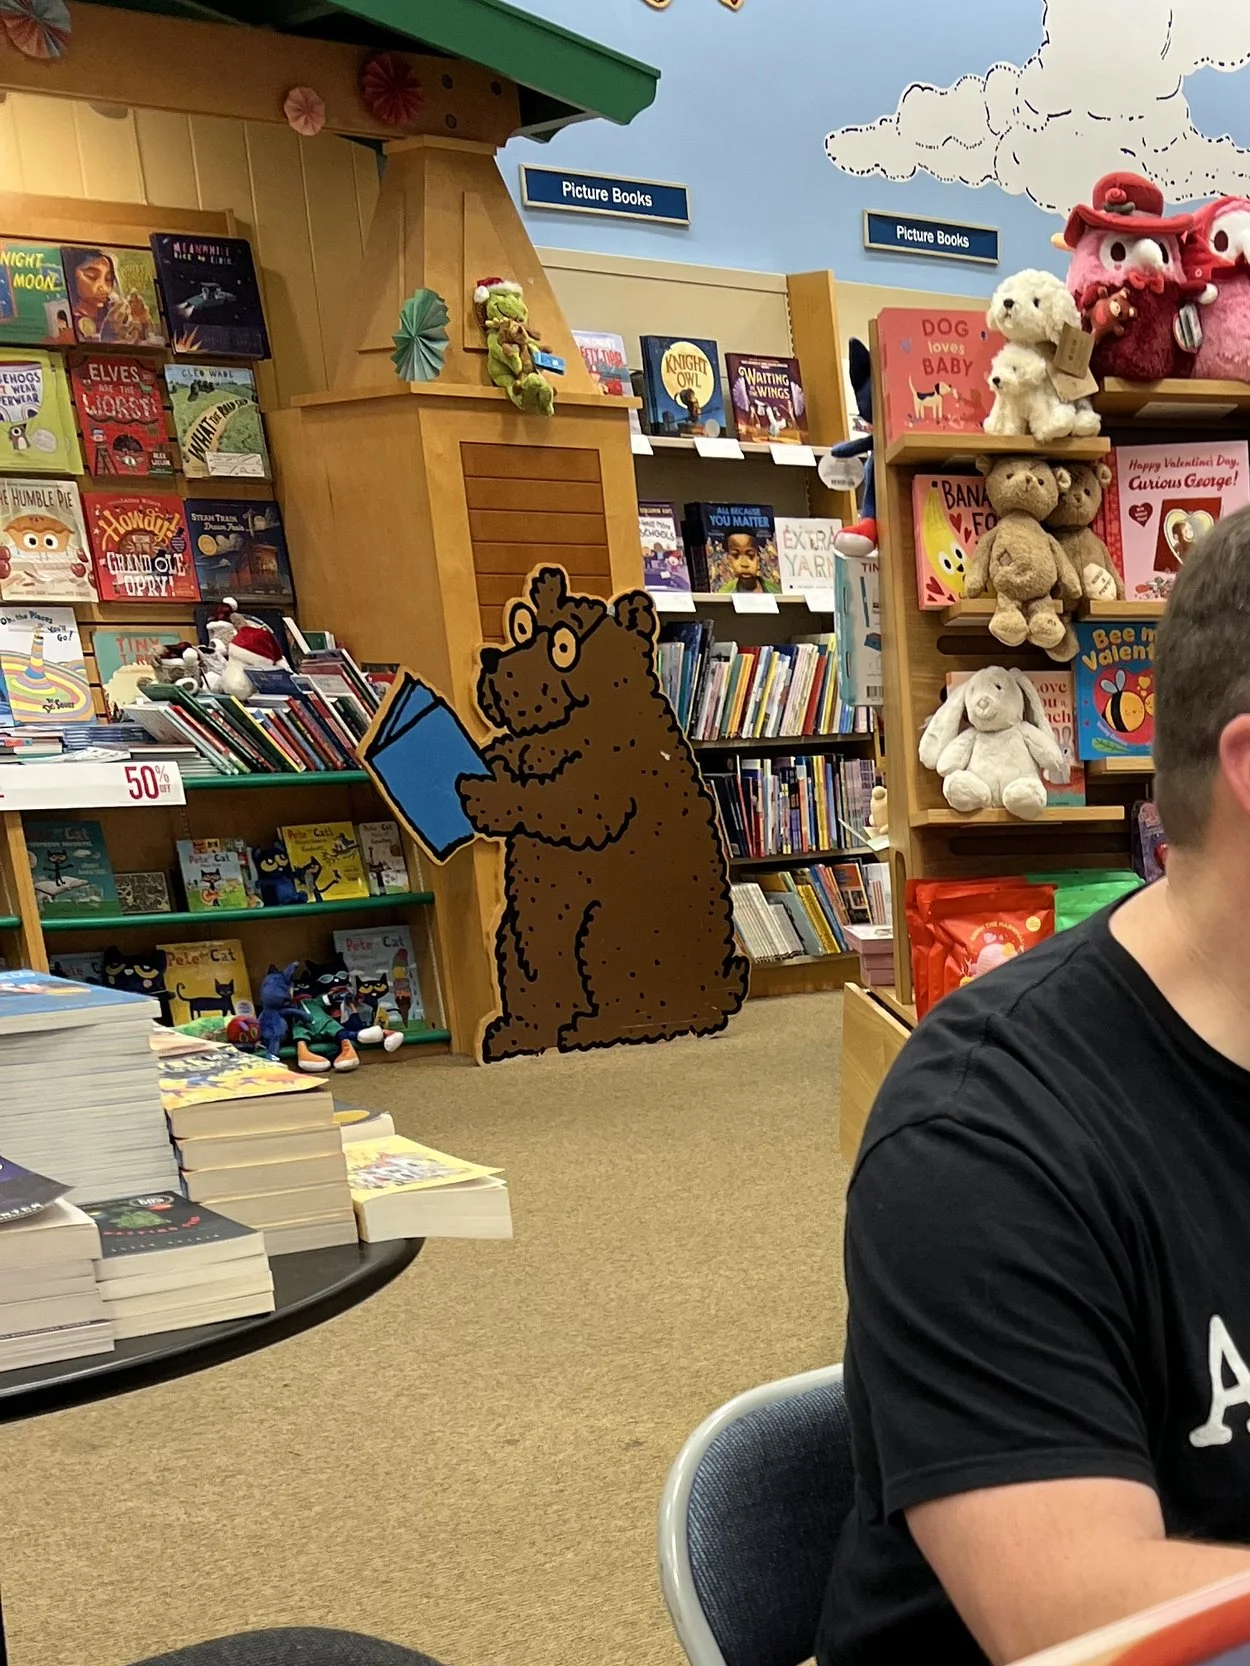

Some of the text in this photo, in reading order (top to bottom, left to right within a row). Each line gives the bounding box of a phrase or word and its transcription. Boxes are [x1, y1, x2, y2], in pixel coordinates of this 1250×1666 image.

[562, 181, 653, 207] Picture Books
[896, 225, 969, 248] Picture Books
[13, 272, 56, 290] MOON
[921, 318, 970, 338] DOG
[928, 341, 966, 355] loves
[89, 363, 140, 383] ELVES
[181, 369, 234, 378] CLEO WADE
[665, 353, 708, 376] KNIGHT
[922, 357, 974, 376] BABY
[677, 371, 701, 388] OWL
[738, 366, 790, 386] WAITING
[758, 385, 790, 400] WINGS
[82, 393, 158, 420] WORST!
[188, 415, 216, 463] WHAT
[210, 411, 223, 425] THE
[1128, 457, 1161, 473] Happy
[1164, 455, 1213, 469] Valentine's
[1128, 470, 1239, 492] Curious George!
[11, 488, 54, 508] HUMBLE
[57, 489, 73, 509] PIE
[709, 514, 770, 528] YOU MATTER
[716, 507, 761, 517] ALL BECAUSE
[98, 508, 180, 552] Howdy!
[783, 524, 837, 550] EXTRA
[106, 551, 186, 577] GRAND OLE
[123, 574, 176, 597] OPRY!
[30, 610, 53, 624] Places
[57, 630, 73, 641] Go!
[1092, 627, 1135, 650] Bee
[215, 854, 230, 863] Cat
[345, 938, 373, 950] Pete
[166, 952, 200, 967] Pete
[210, 949, 236, 962] Cat
